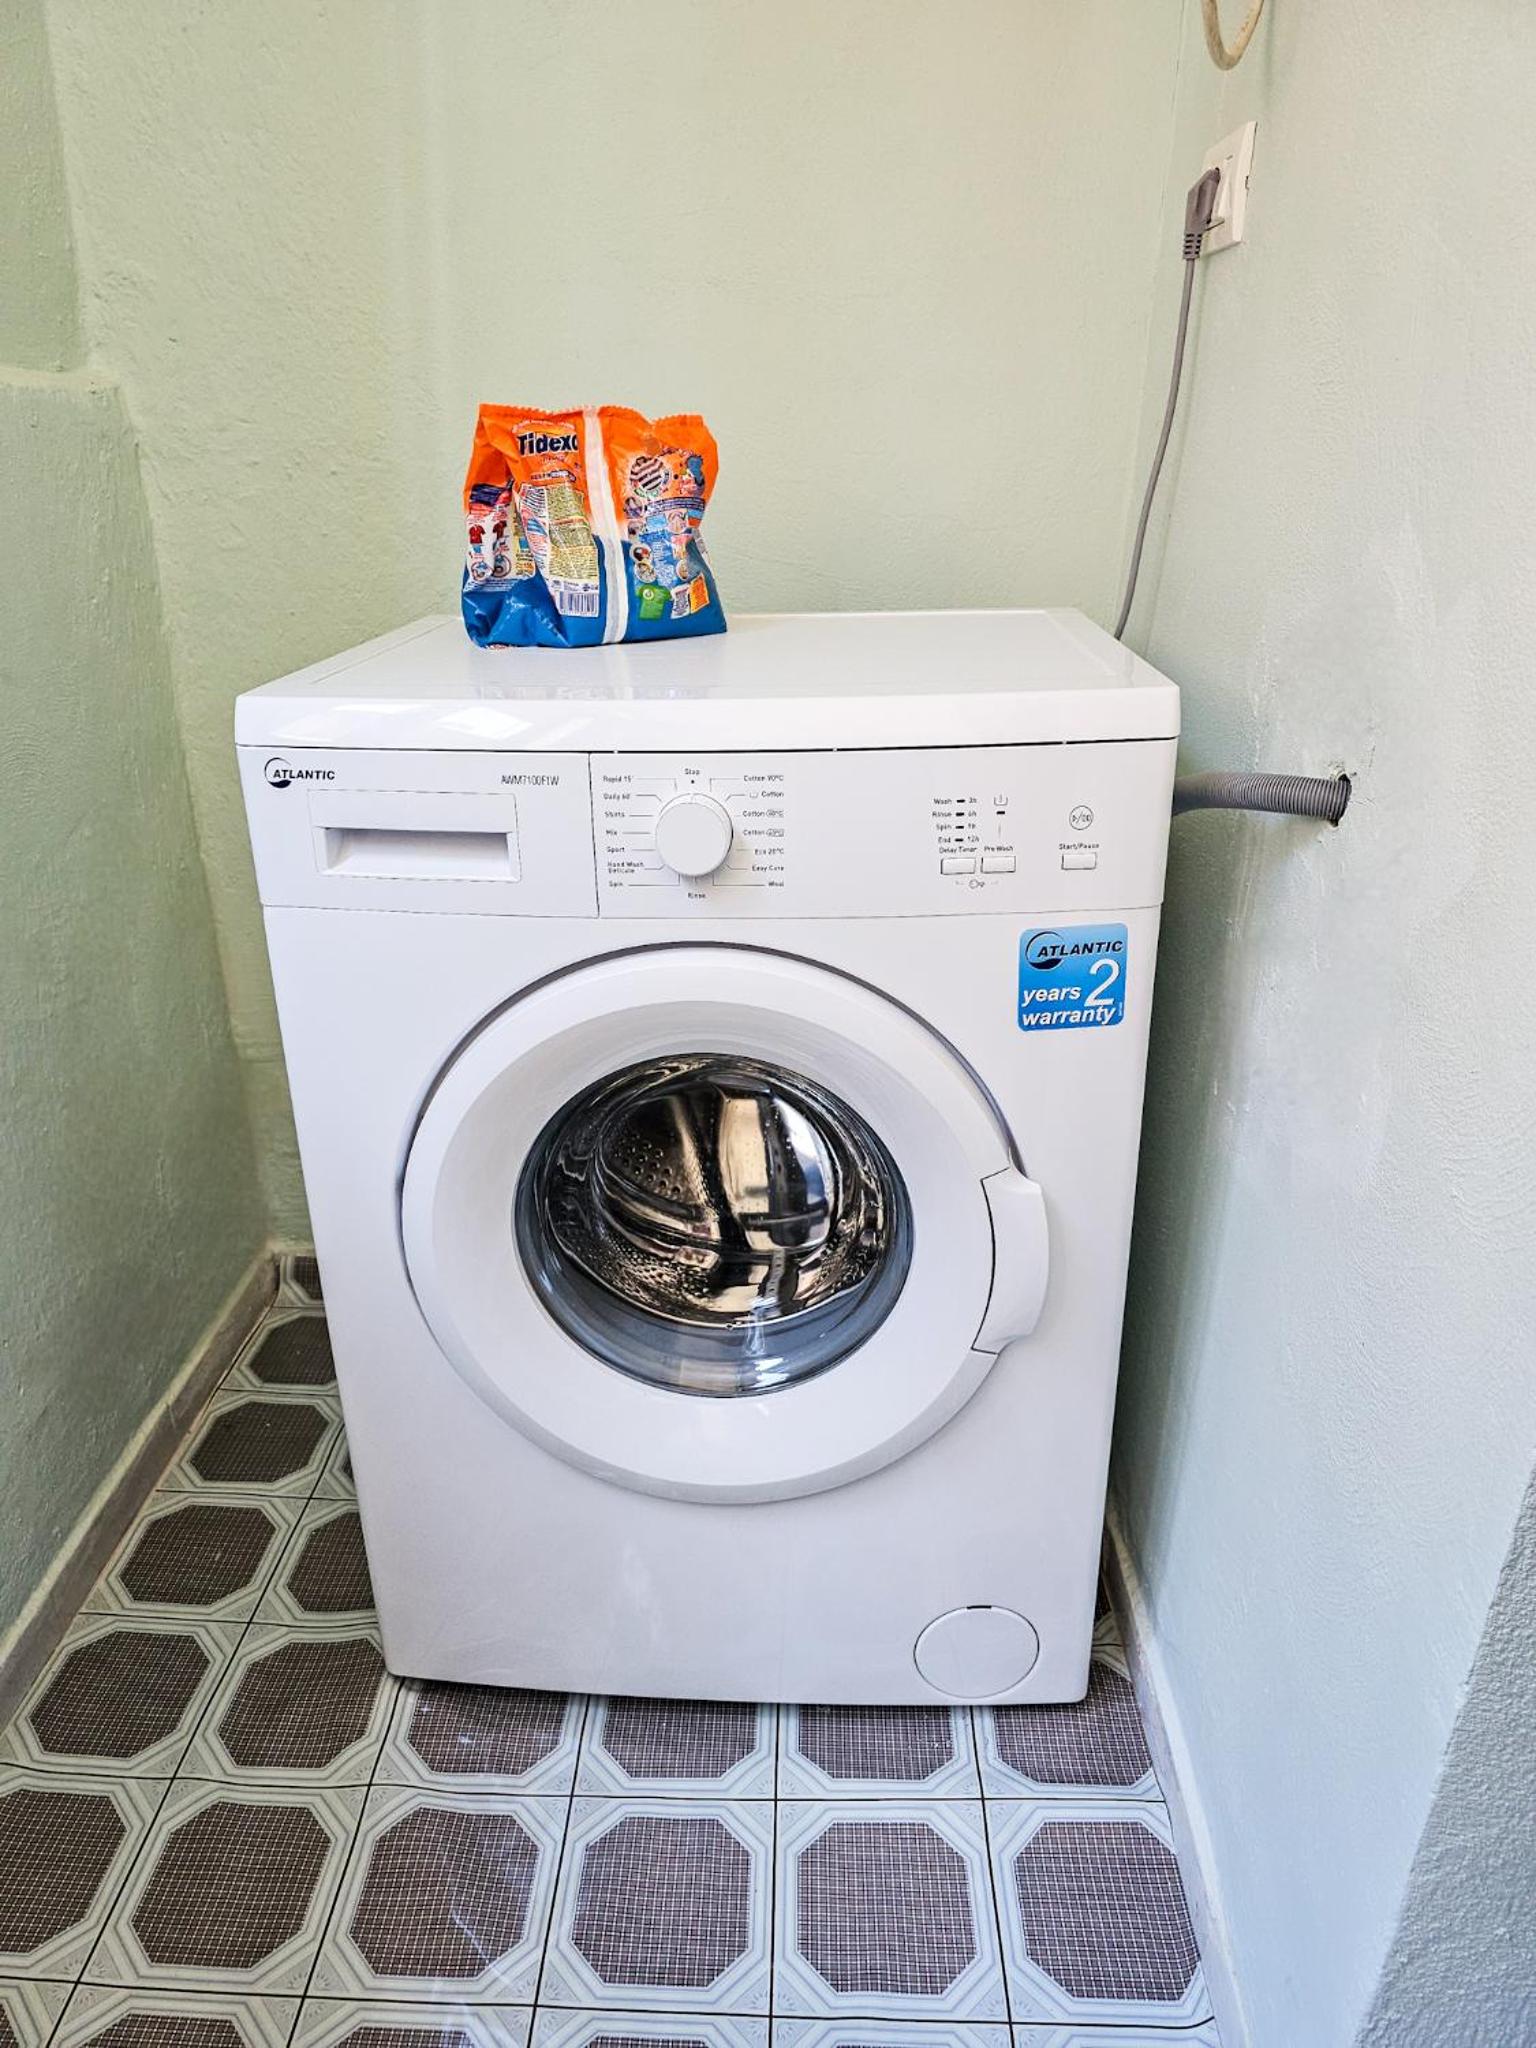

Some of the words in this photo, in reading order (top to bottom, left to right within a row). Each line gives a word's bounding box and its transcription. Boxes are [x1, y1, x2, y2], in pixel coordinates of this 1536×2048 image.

[273, 769, 335, 780] ATLANTIC
[684, 768, 700, 776] Stop
[603, 775, 622, 784] Rapid
[603, 793, 621, 802] Daily
[761, 790, 785, 798] Cotton
[742, 810, 766, 818] Cotton
[936, 823, 952, 831] Spin
[606, 846, 625, 854] Sport
[752, 865, 767, 873] Easy
[1037, 940, 1122, 957] ATLANTIC
[1084, 958, 1120, 1007] 2
[1021, 986, 1081, 1008] years
[1022, 1004, 1116, 1025] warranty
